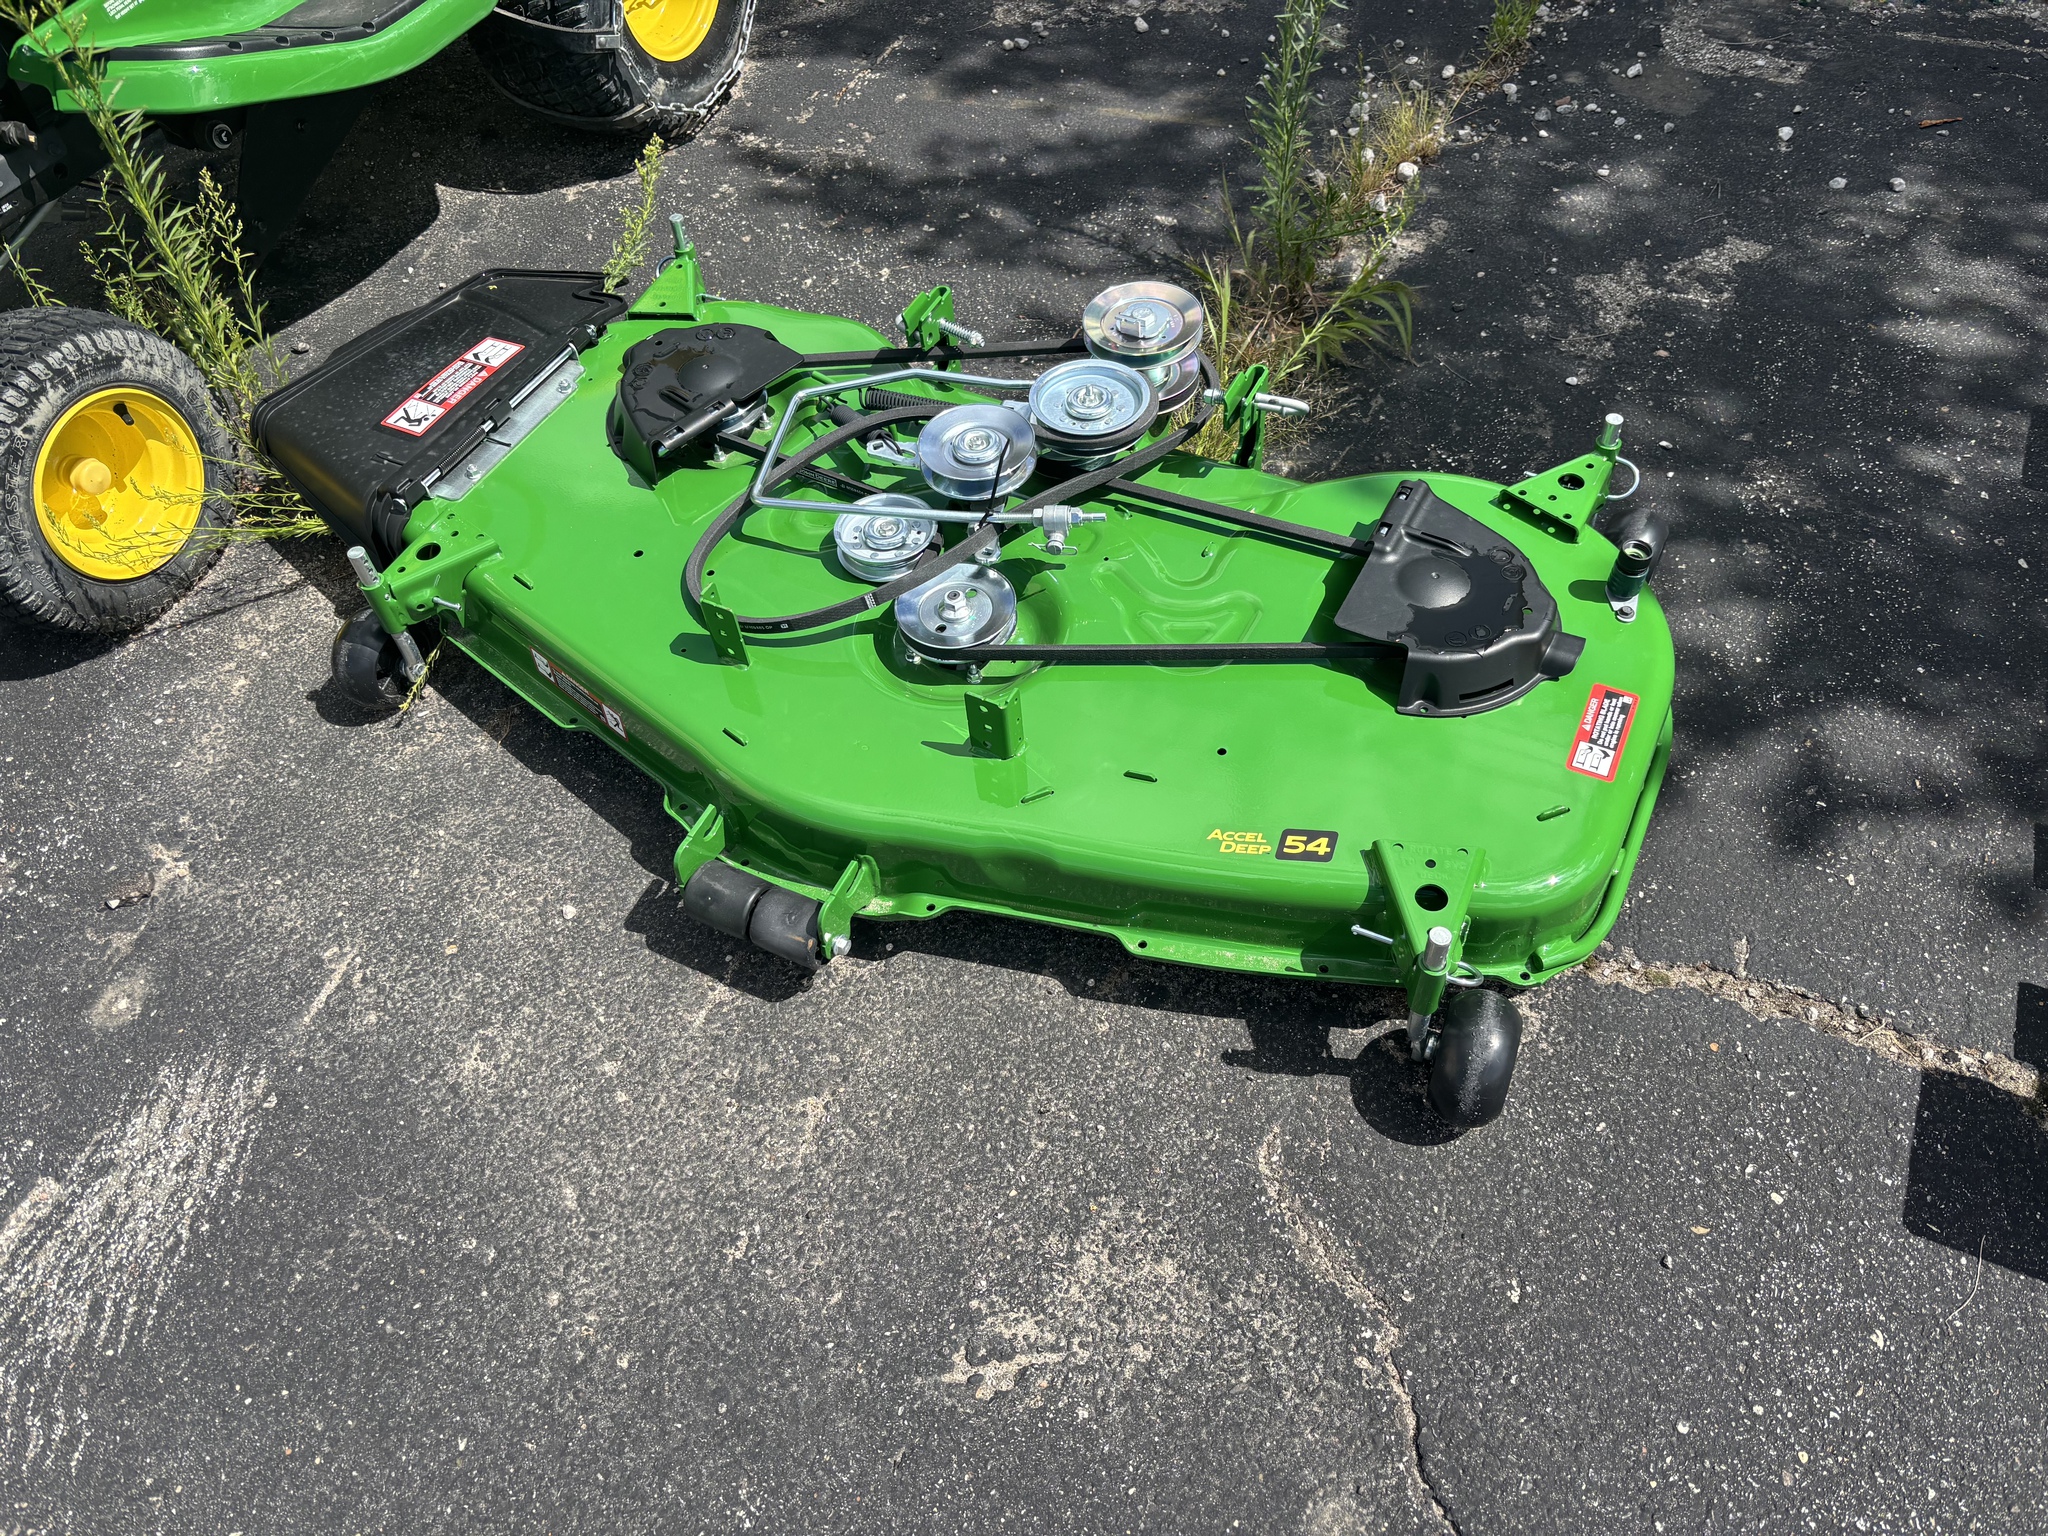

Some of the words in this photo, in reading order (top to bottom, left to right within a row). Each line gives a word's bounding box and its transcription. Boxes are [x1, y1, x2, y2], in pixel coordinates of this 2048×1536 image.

[447, 375, 484, 405] DANGER
[5, 434, 32, 554] MASTER
[1584, 698, 1599, 724] DANGER
[1591, 714, 1604, 739] ROTATING
[1600, 698, 1610, 714] BLADE
[1206, 828, 1268, 843] ACCEL
[1219, 840, 1272, 855] DEEP
[1282, 835, 1331, 856] 54
